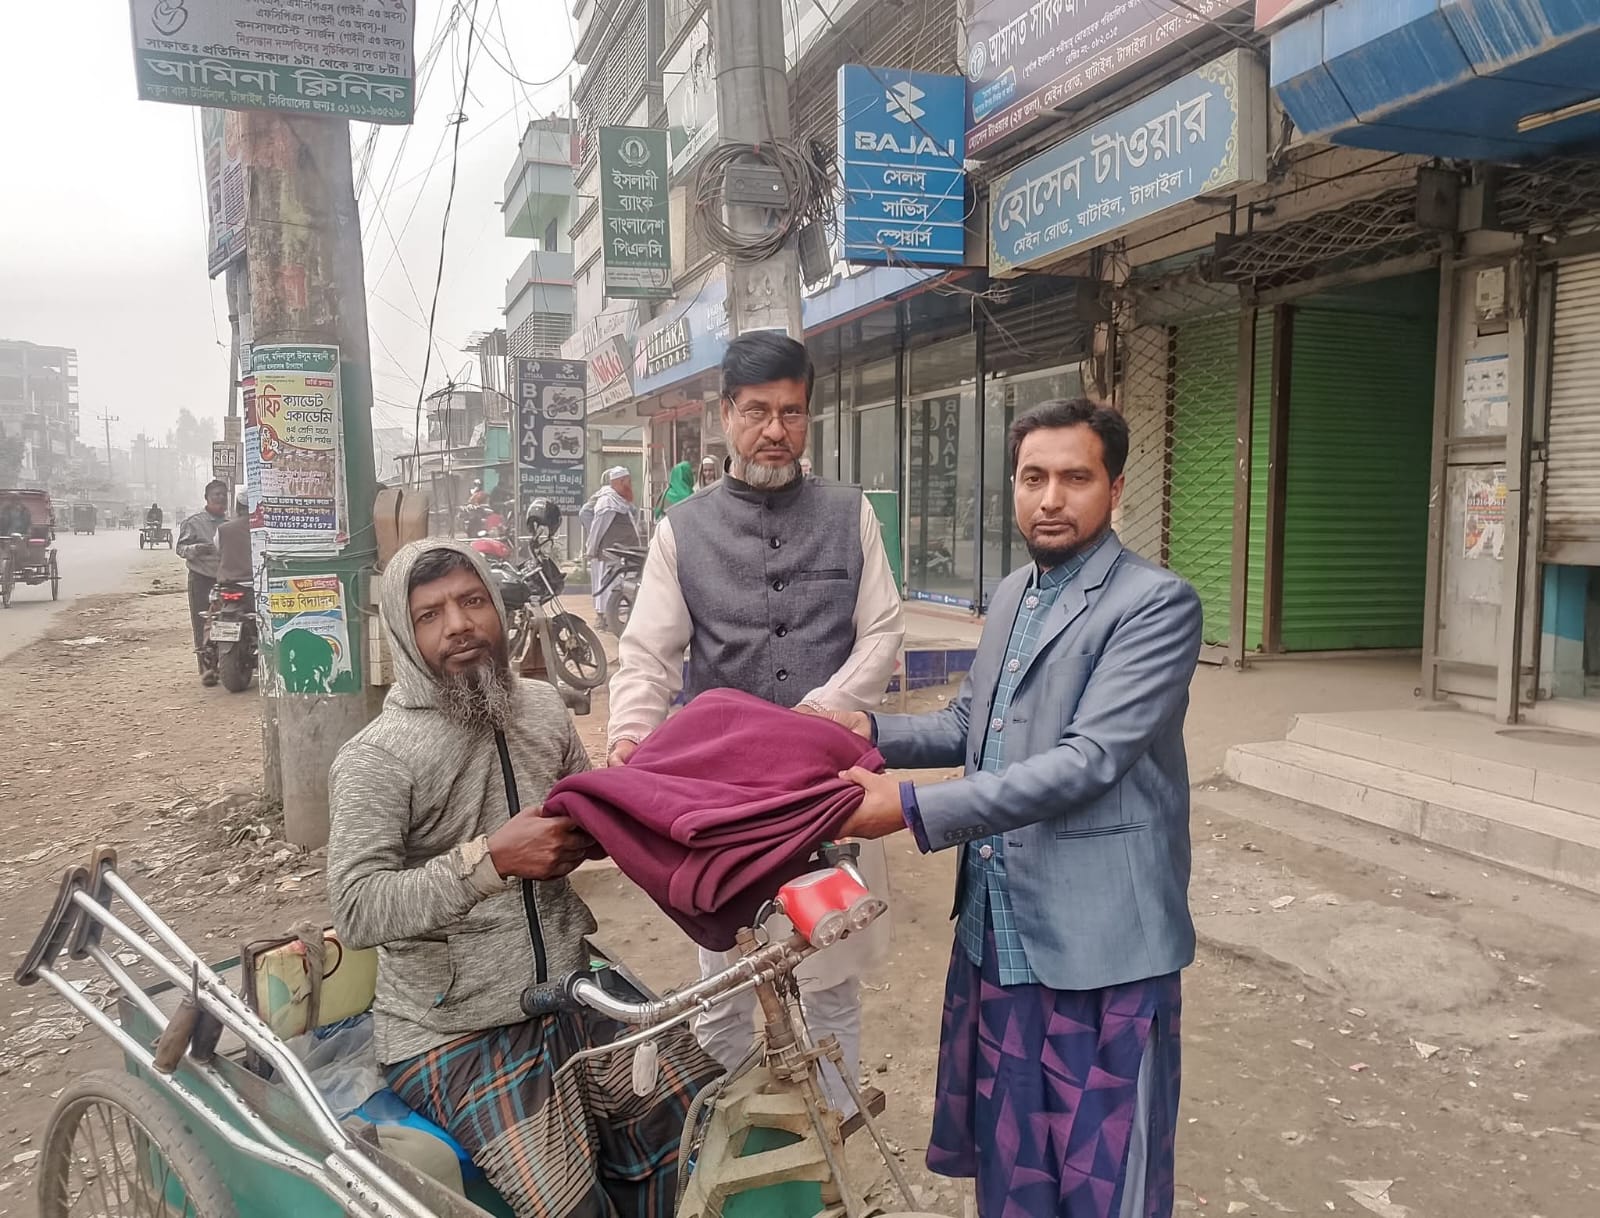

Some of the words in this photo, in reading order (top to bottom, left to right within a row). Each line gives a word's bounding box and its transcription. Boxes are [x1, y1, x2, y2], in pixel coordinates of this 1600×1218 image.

[988, 11, 1028, 69] আমানত
[143, 57, 281, 93] আমিনা
[289, 68, 408, 103] ক্লিনিক
[855, 130, 956, 158] BAJAJ
[999, 155, 1087, 233] হোসেন
[1090, 90, 1213, 185] টাওয়ার
[611, 168, 660, 192] ইসলামী
[883, 168, 928, 191] সেলস্
[618, 194, 654, 213] ব্যাংক
[1013, 229, 1041, 256] মেইন
[1043, 216, 1074, 242] রোড,
[1077, 194, 1127, 229] ঘাটাইল,
[1129, 168, 1185, 206] টাঙ্গাইল
[608, 217, 665, 237] বাংলাদেশ
[876, 226, 932, 248] স্পেয়ার্স
[612, 237, 663, 259] পিএলসি
[283, 392, 324, 408] ক্যাডেট
[284, 407, 333, 423] একাডেমি
[522, 382, 539, 462] BAJAJ
